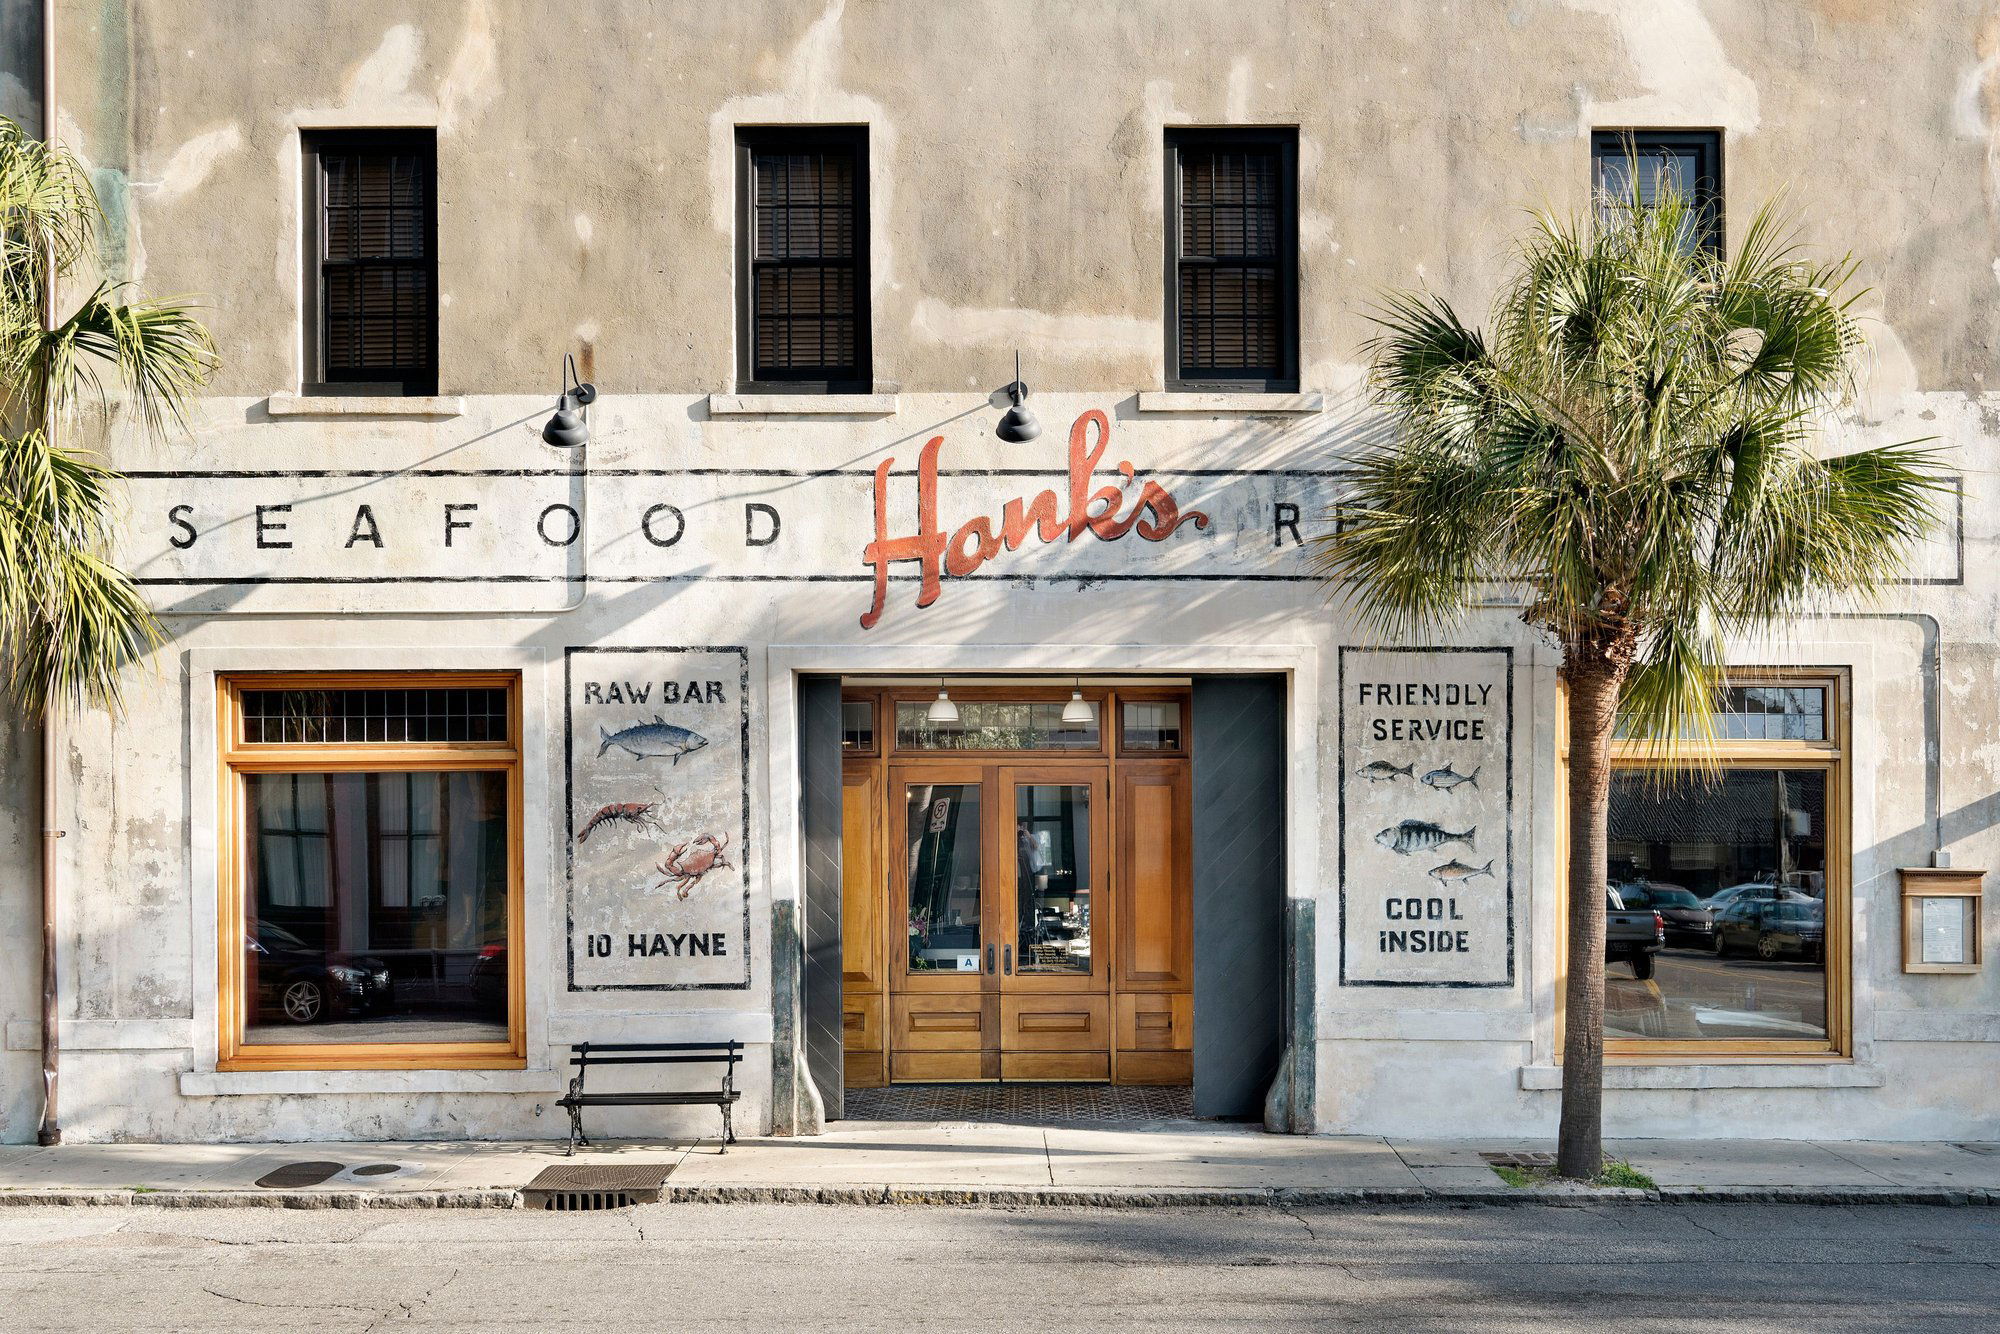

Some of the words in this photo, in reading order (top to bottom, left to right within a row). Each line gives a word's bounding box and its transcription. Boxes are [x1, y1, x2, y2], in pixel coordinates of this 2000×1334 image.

[168, 503, 782, 550] SEAFOOD
[859, 408, 1208, 630] Hank's
[584, 681, 652, 705] RAW
[663, 680, 727, 705] BAR
[1359, 682, 1493, 706] FRIENDLY
[1372, 718, 1485, 742] SERVICE
[1386, 897, 1464, 921] COOL
[628, 932, 727, 957] HAYNE
[1379, 929, 1470, 953] INSIDE
[965, 958, 973, 967] A
